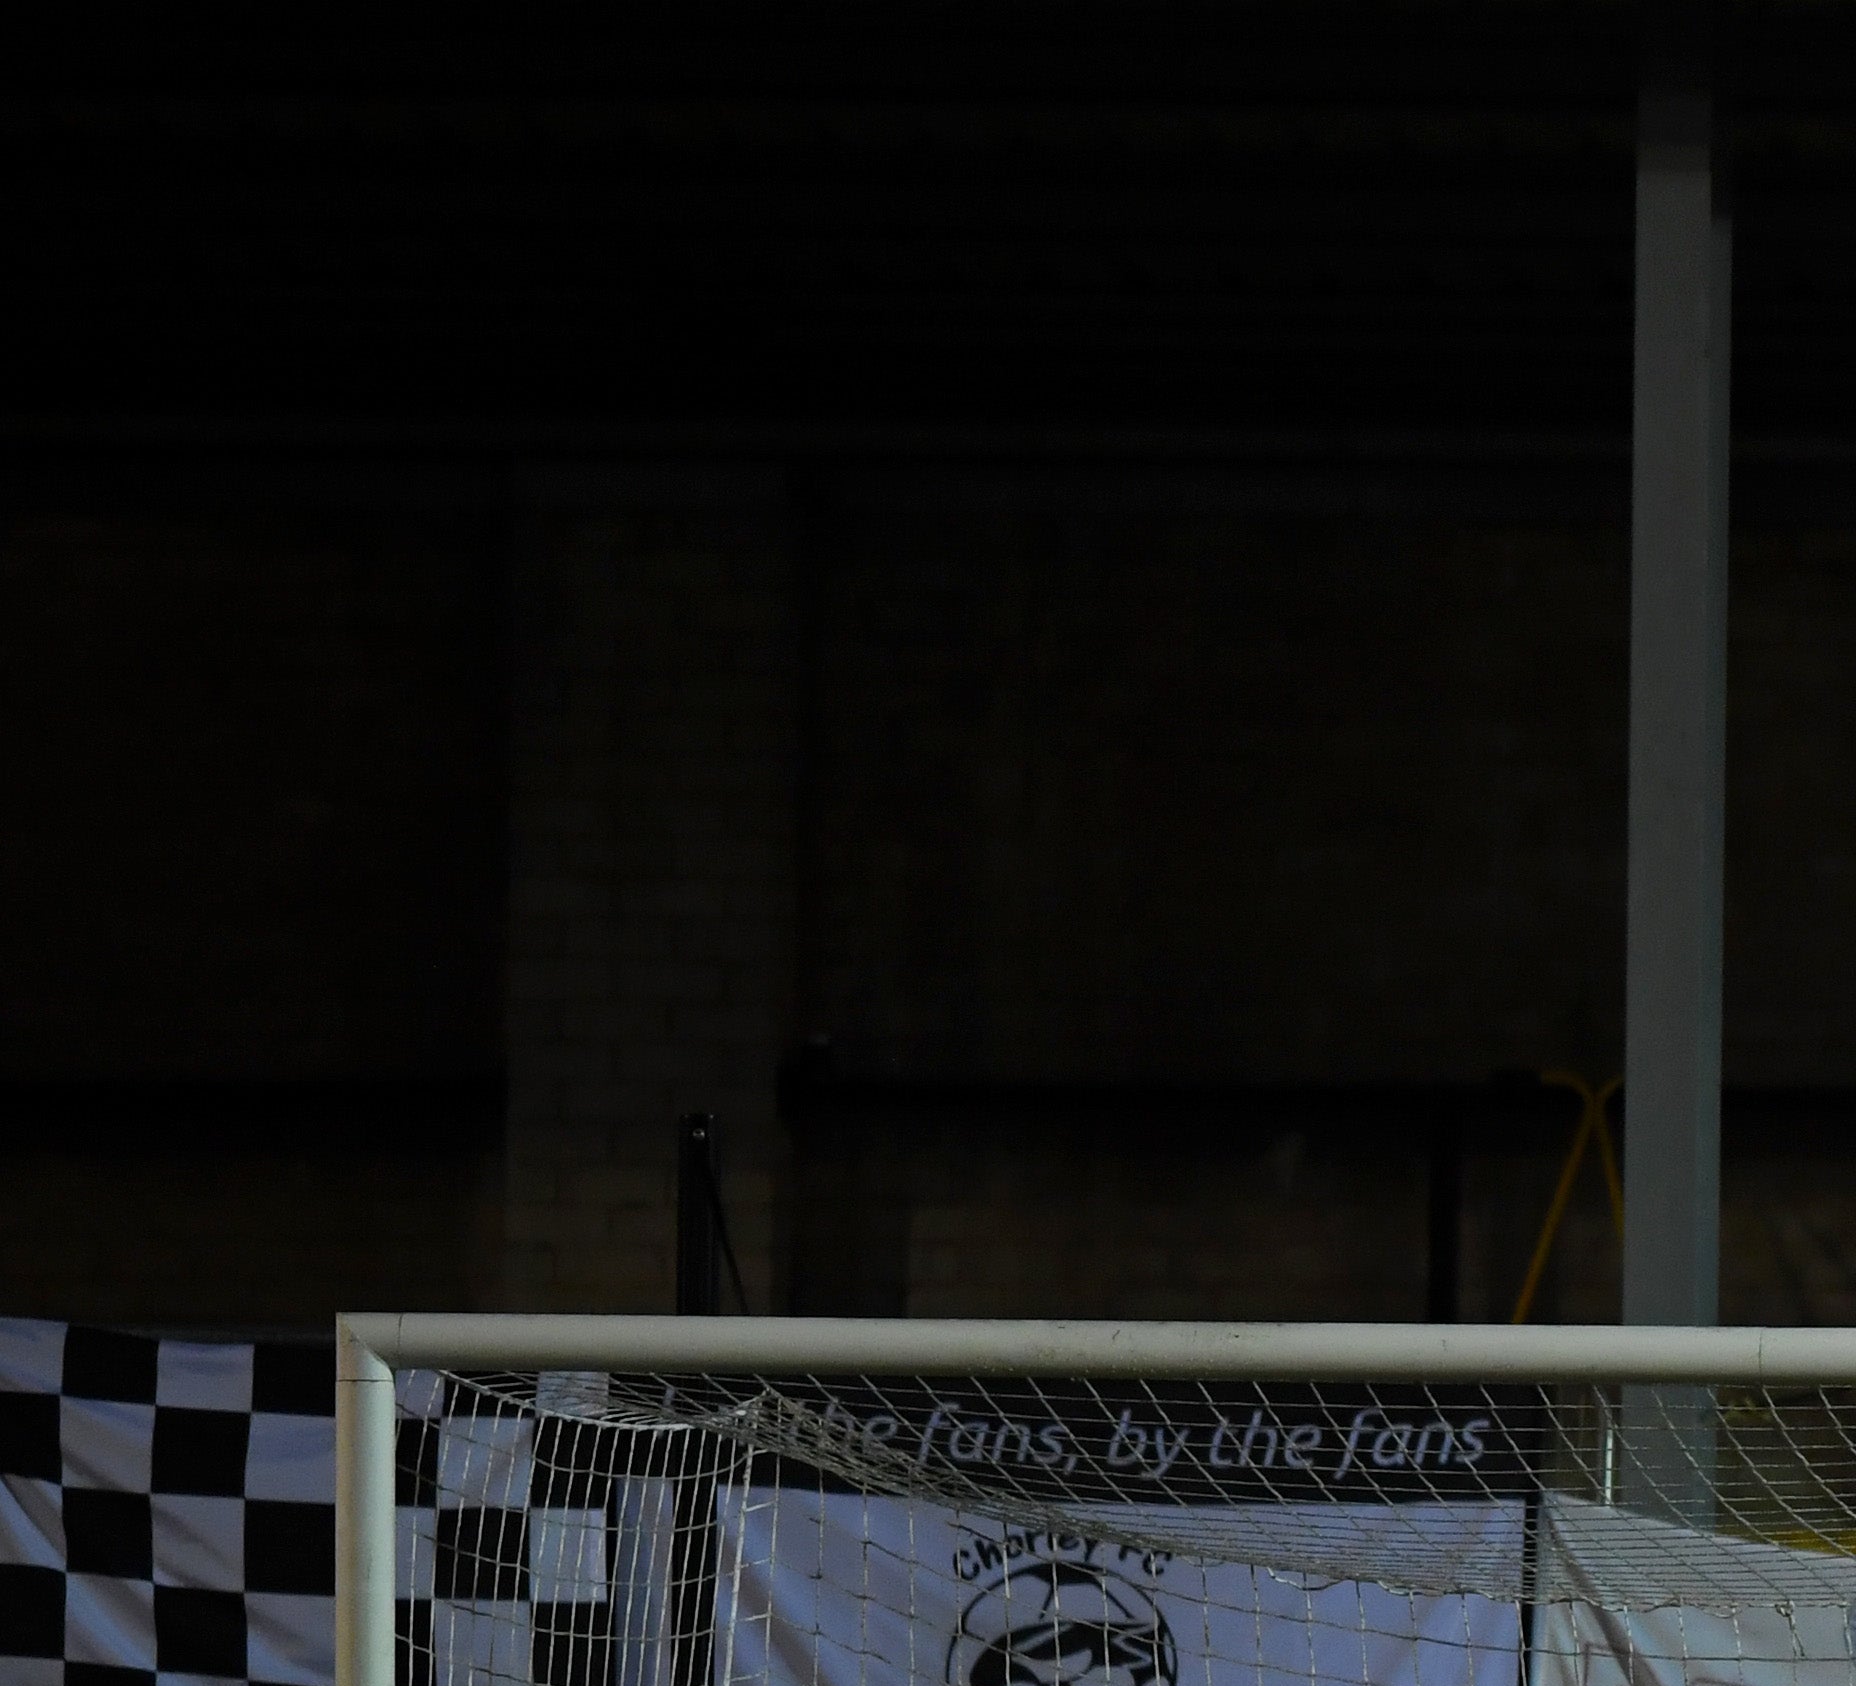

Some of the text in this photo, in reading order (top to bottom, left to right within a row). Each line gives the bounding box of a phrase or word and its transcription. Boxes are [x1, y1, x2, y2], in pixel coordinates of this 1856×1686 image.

[911, 1402, 1082, 1477] fans,
[1105, 1407, 1191, 1481] by
[1207, 1407, 1322, 1470] the
[1332, 1406, 1491, 1481] fans
[953, 1529, 1099, 1581] Chorley
